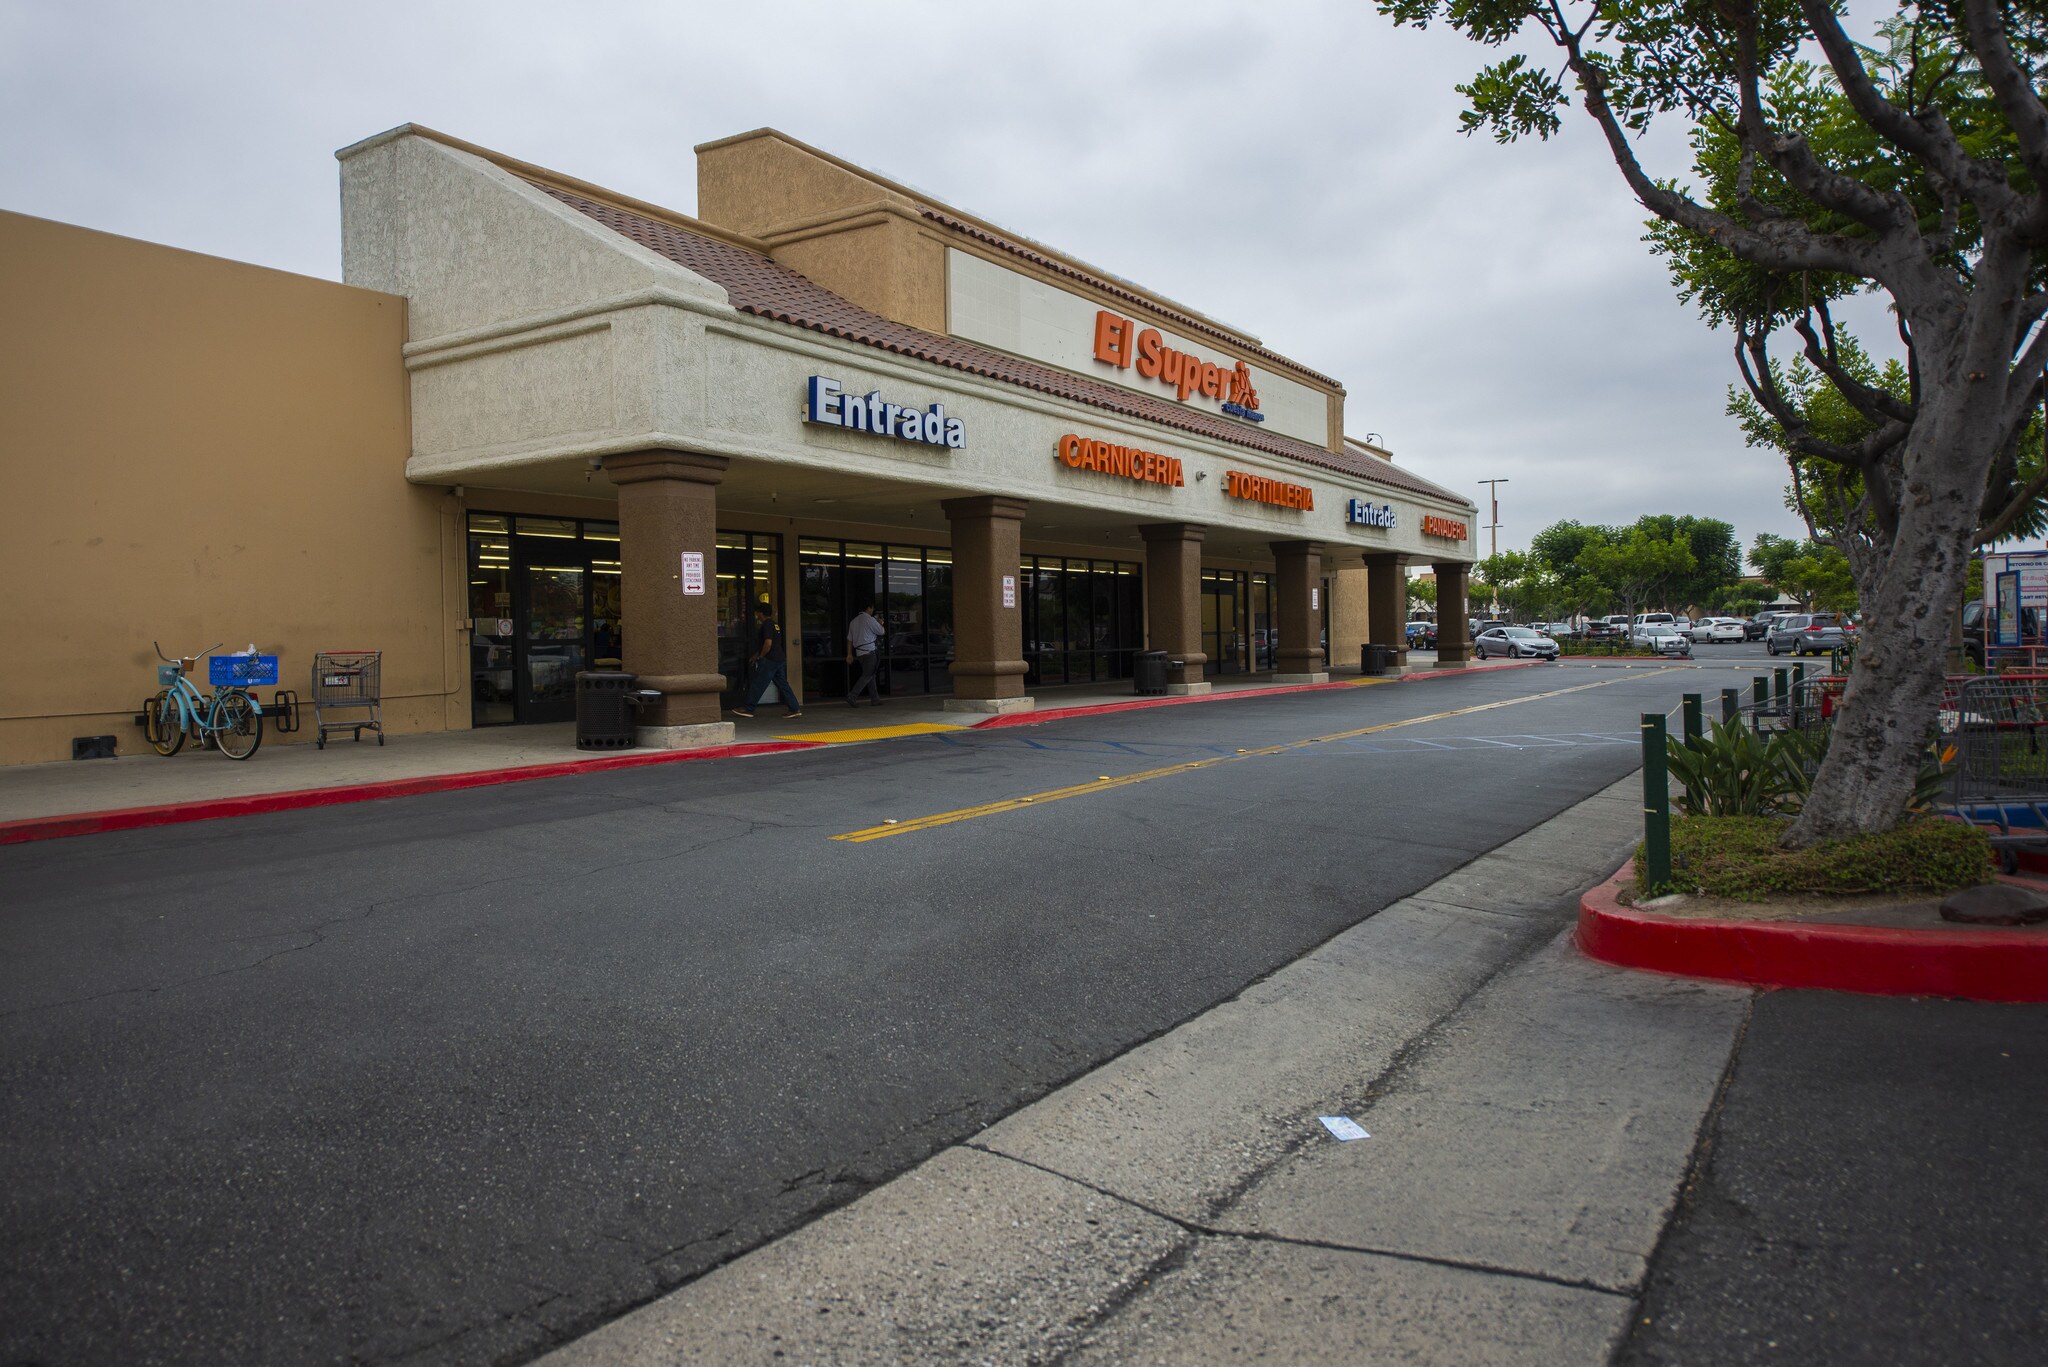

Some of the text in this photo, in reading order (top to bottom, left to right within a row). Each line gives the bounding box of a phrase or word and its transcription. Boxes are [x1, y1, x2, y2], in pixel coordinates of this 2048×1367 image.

[1094, 310, 1232, 401] El Super
[809, 375, 967, 449] Entrada
[1059, 433, 1185, 488] CARNICERIA
[1226, 470, 1315, 512] TORTILLERIA
[1350, 498, 1397, 529] Entrada
[1424, 515, 1467, 541] PANADERIA
